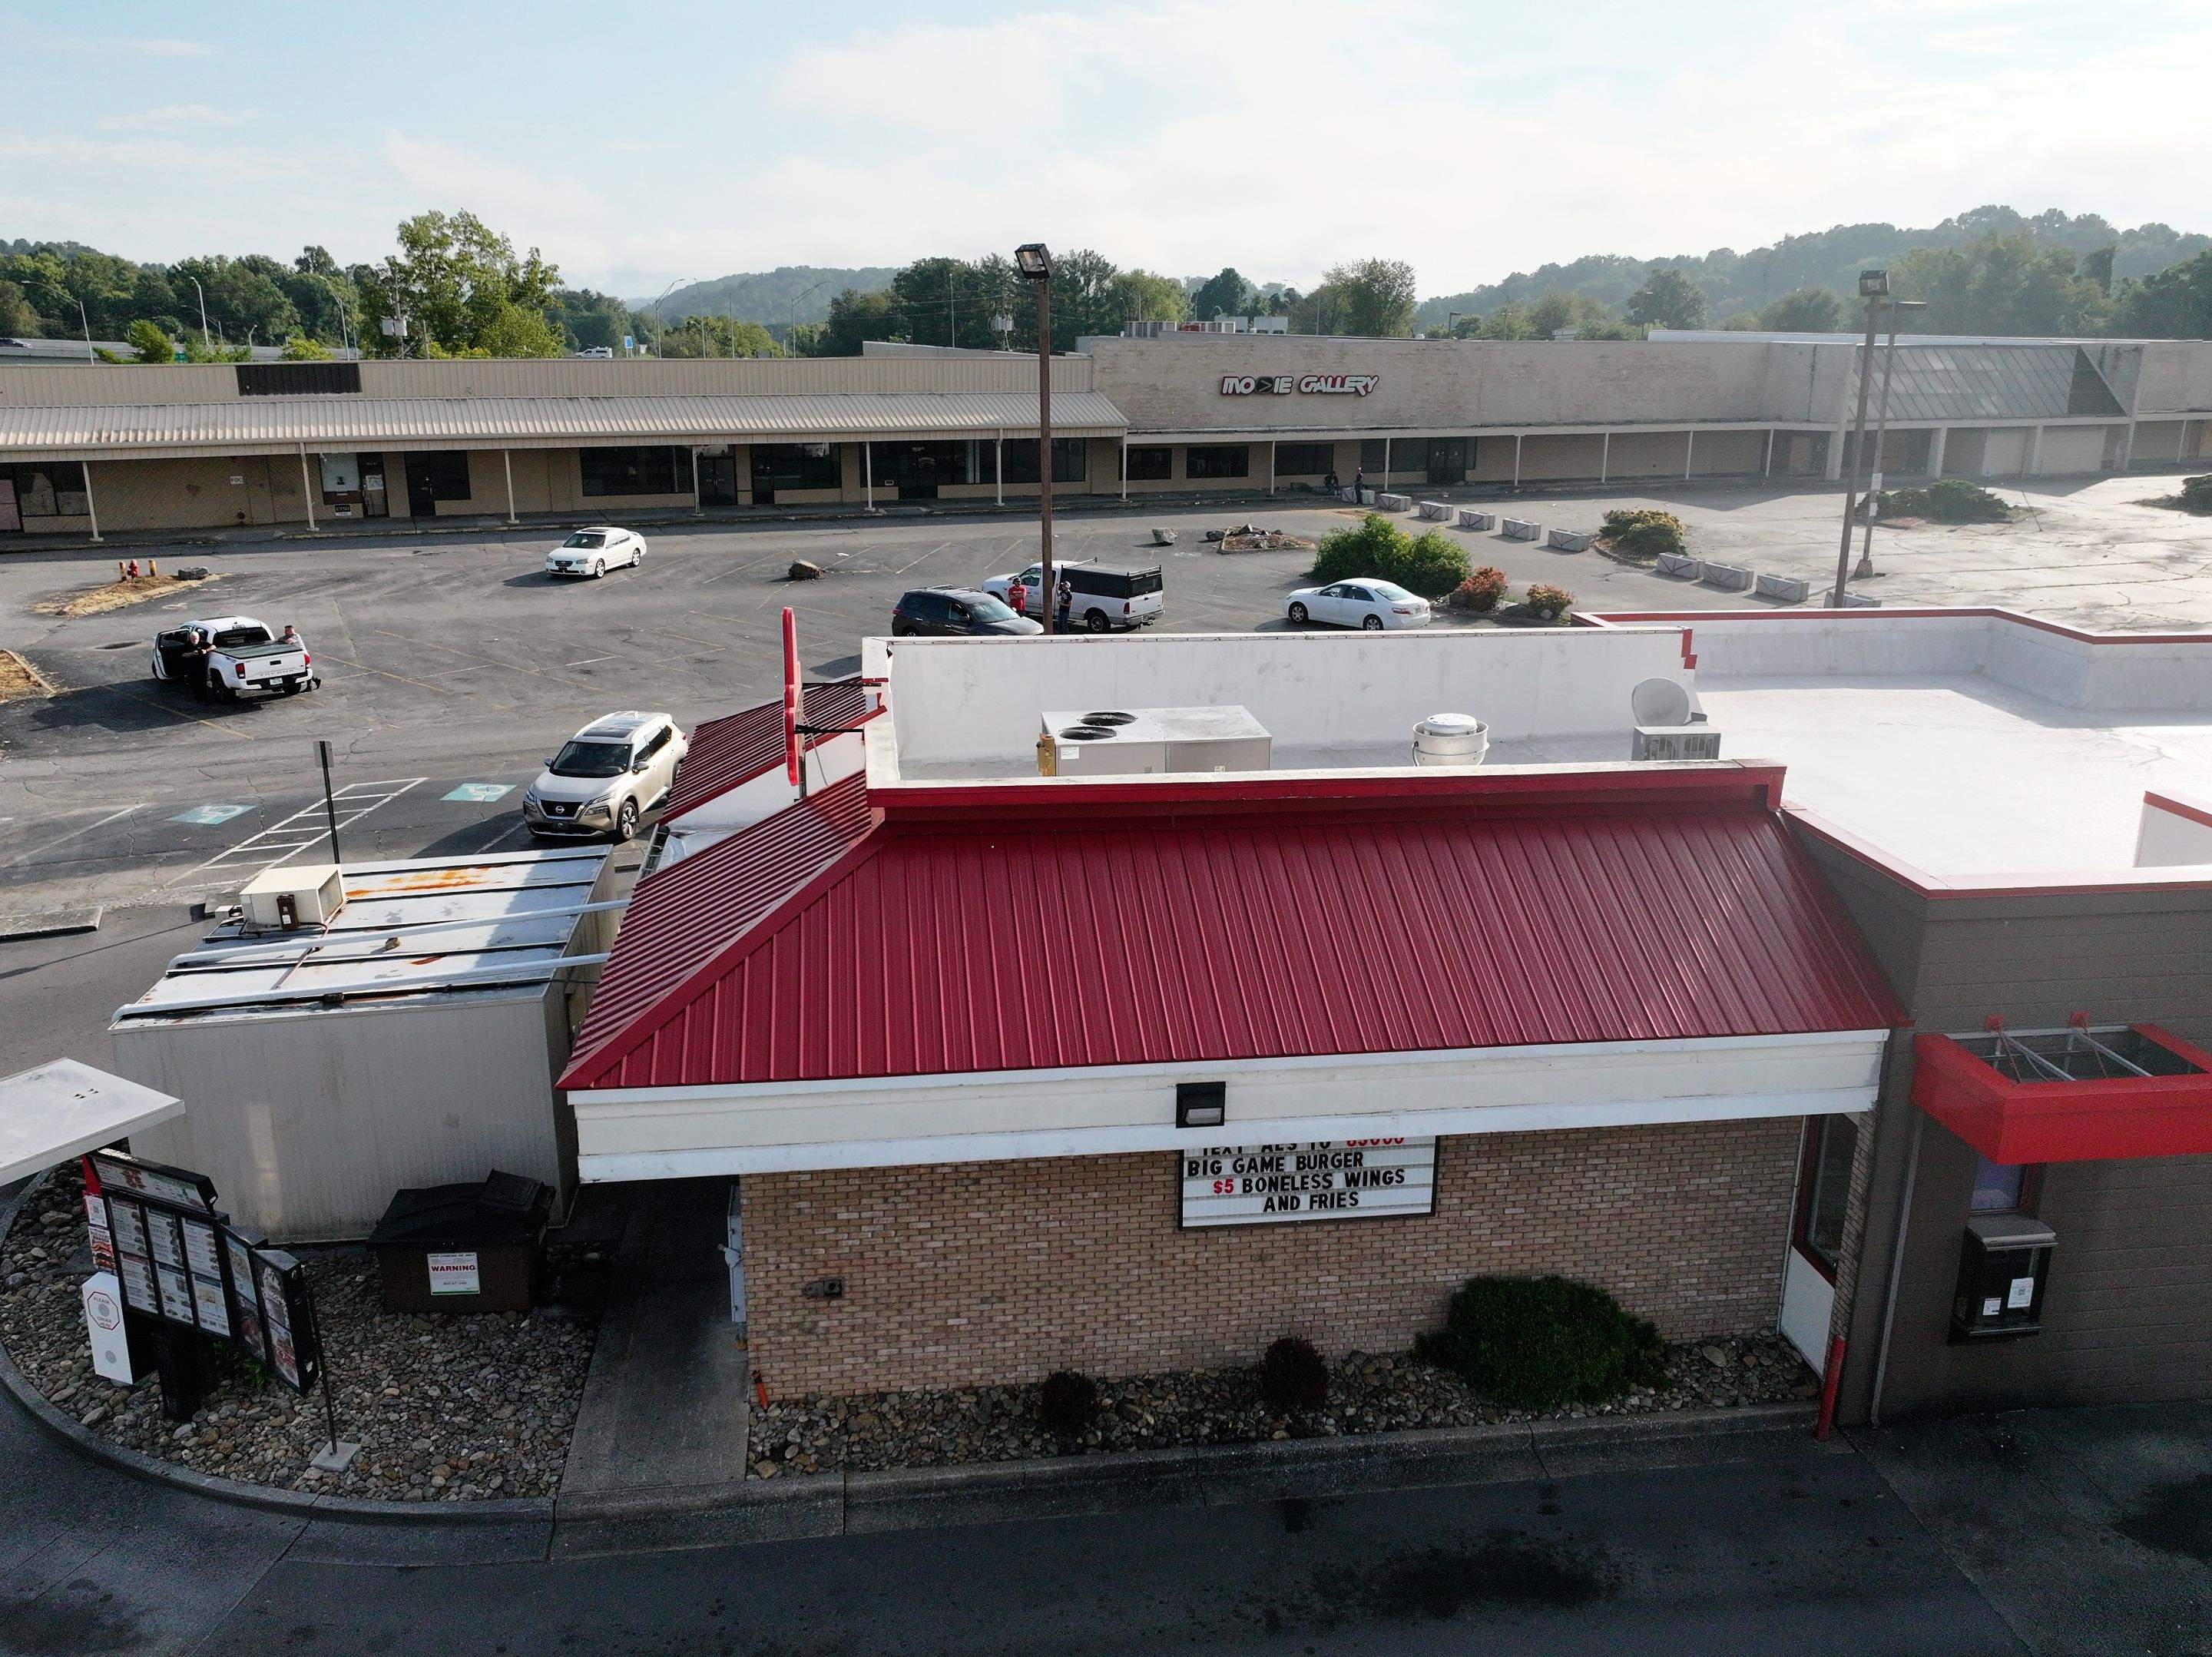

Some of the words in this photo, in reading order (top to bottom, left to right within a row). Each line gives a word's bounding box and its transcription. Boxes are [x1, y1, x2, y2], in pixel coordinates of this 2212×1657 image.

[1221, 376, 1293, 396] MOVIE
[1299, 375, 1379, 396] GALLERY
[1187, 1159, 1223, 1177] BIG
[1232, 1156, 1285, 1174] GAME
[1296, 1152, 1363, 1171] BURGER
[1213, 1178, 1234, 1195] $5
[1242, 1173, 1333, 1194] BONELESS
[1344, 1168, 1406, 1188] WINGS
[1263, 1194, 1300, 1212] AND
[1309, 1191, 1359, 1210] FRIES
